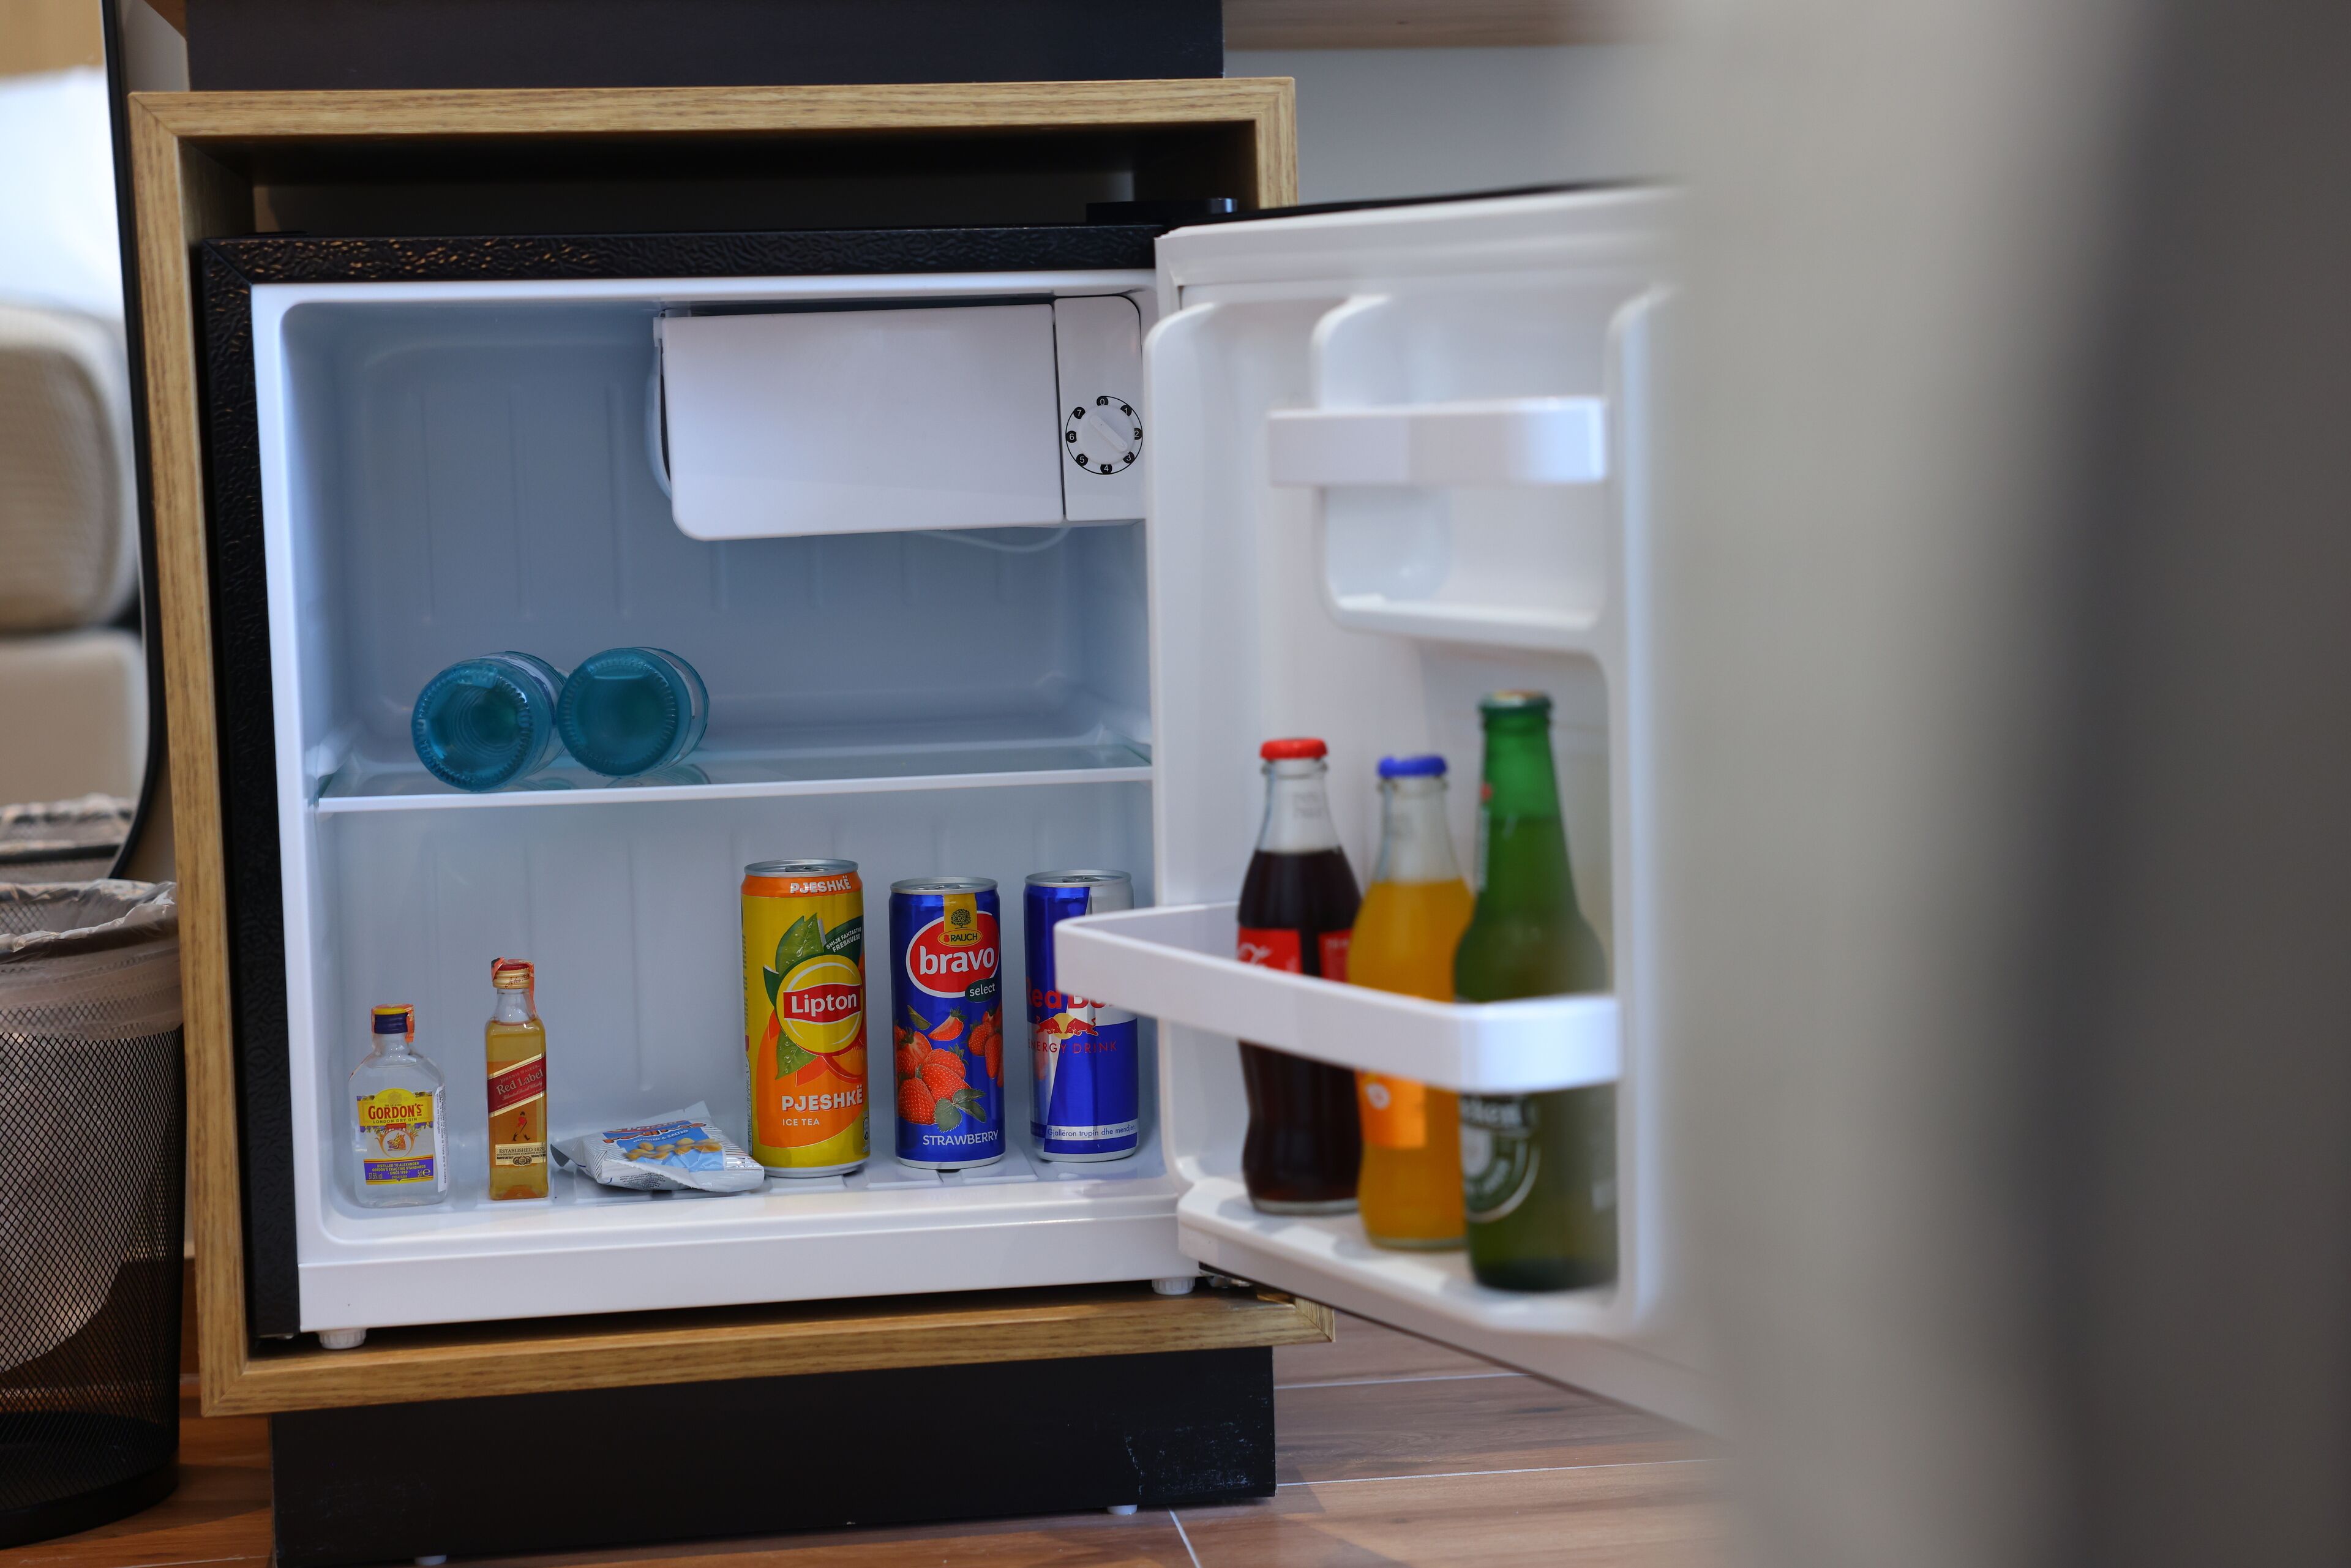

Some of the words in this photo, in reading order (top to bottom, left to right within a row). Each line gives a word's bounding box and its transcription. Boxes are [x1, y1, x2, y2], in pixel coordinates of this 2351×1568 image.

[790, 876, 852, 894] PJESHKË
[827, 937, 841, 949] SHIJE
[833, 933, 860, 953] FRESKUESE
[951, 933, 978, 942] RAUCH
[920, 945, 995, 975] bravo
[969, 983, 996, 997] select
[792, 992, 857, 1016] Lipton
[1073, 1040, 1117, 1054] DRINK
[496, 1079, 517, 1095] Red
[517, 1068, 544, 1086] Label
[781, 1084, 863, 1111] PJESHKË
[368, 1103, 422, 1120] GORDON'S
[667, 1130, 689, 1138] SALTED
[923, 1130, 999, 1146] STRAWBERRY
[1048, 1128, 1077, 1138] Gjallëron
[1079, 1129, 1099, 1138] trupin
